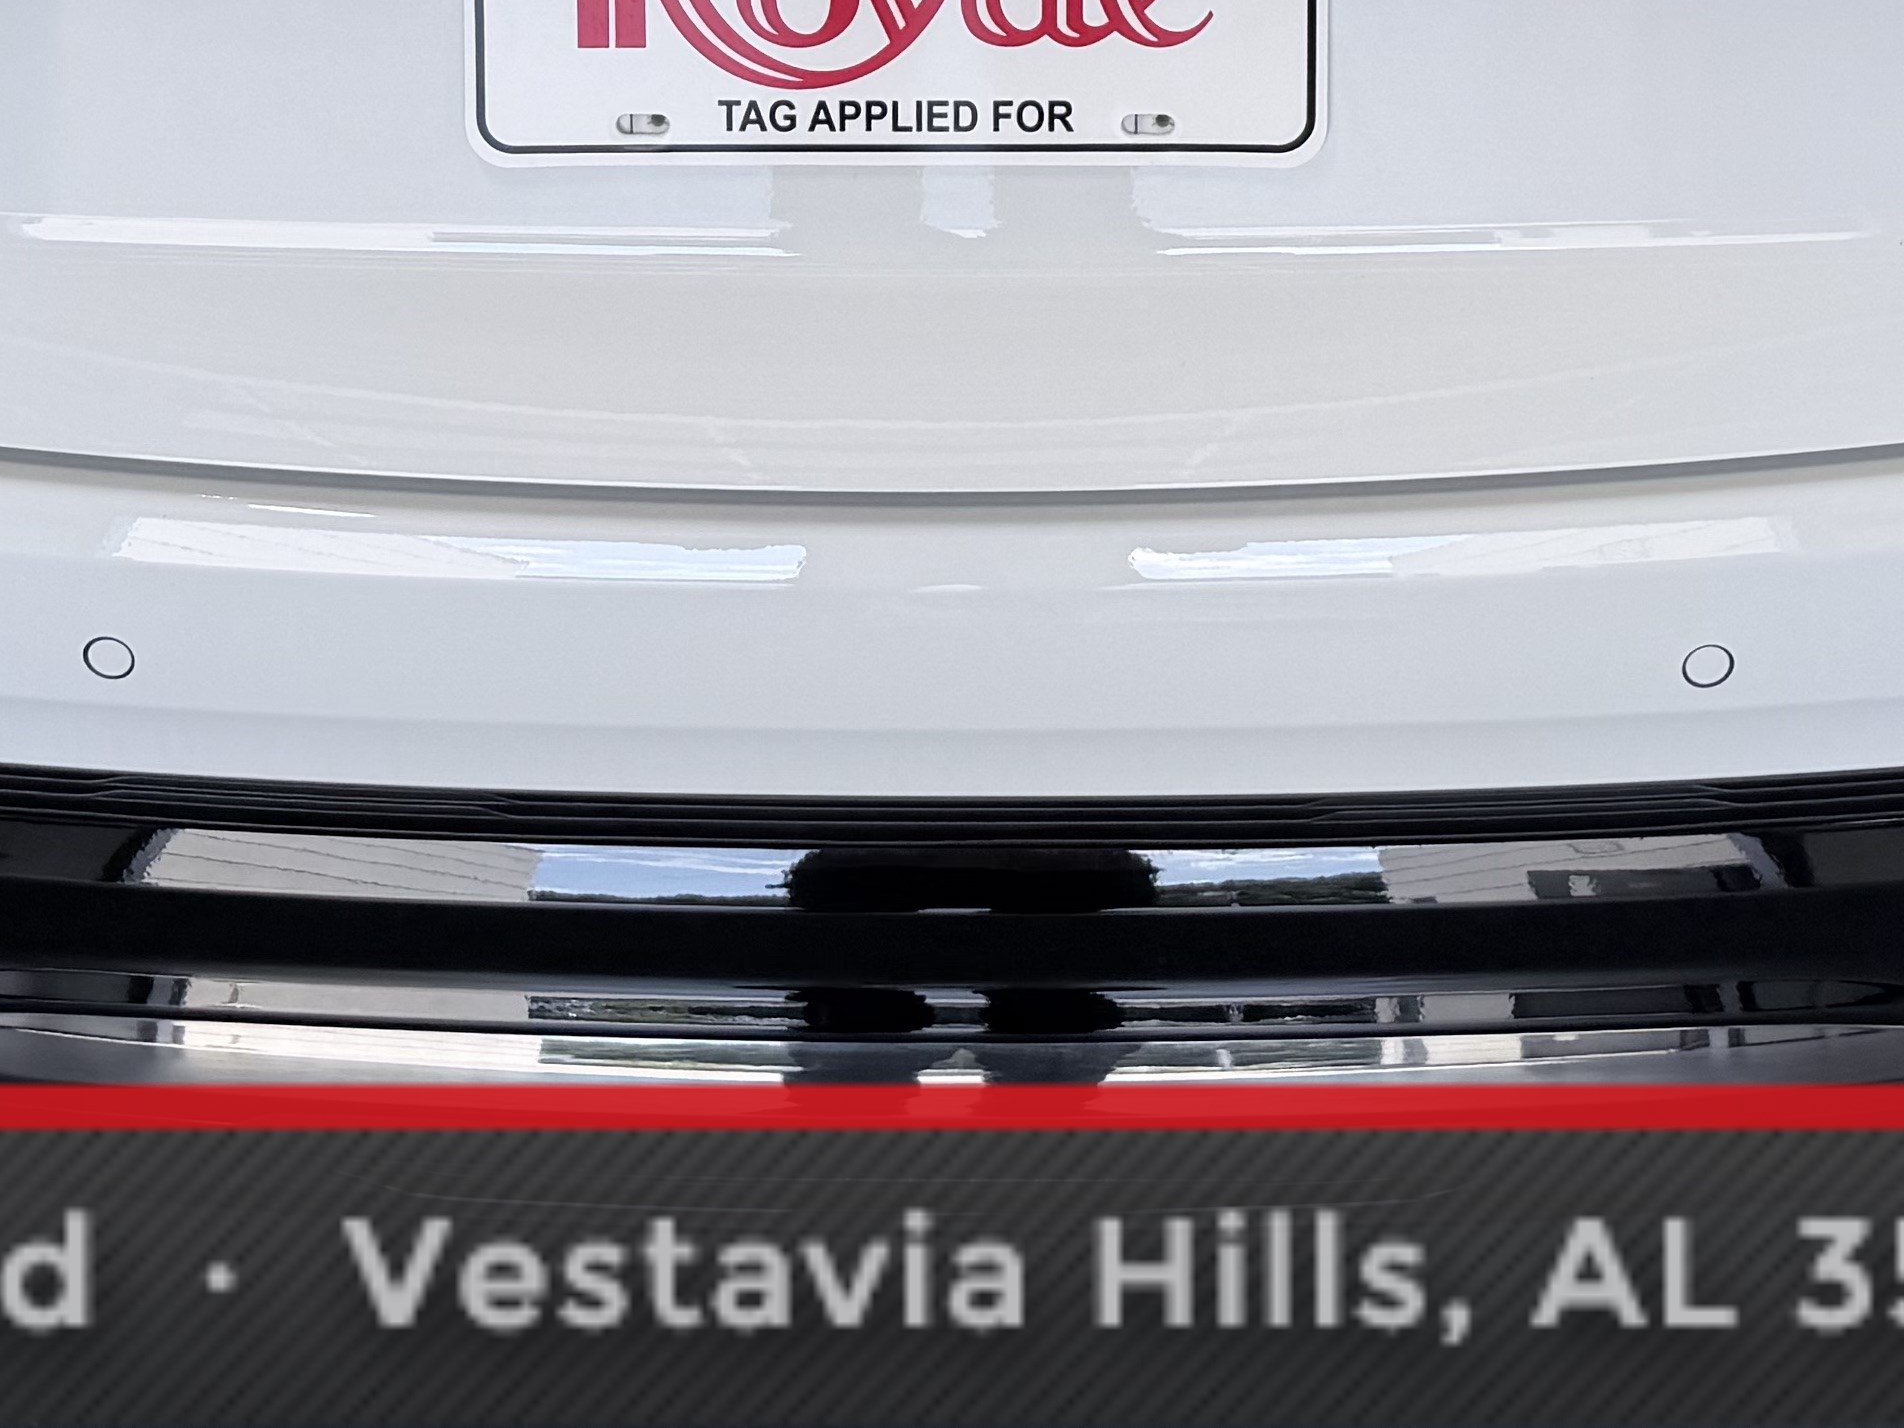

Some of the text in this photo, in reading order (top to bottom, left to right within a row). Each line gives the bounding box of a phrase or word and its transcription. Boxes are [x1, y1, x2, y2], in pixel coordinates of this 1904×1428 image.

[717, 99, 1075, 133] TAG APPLIED FOR
